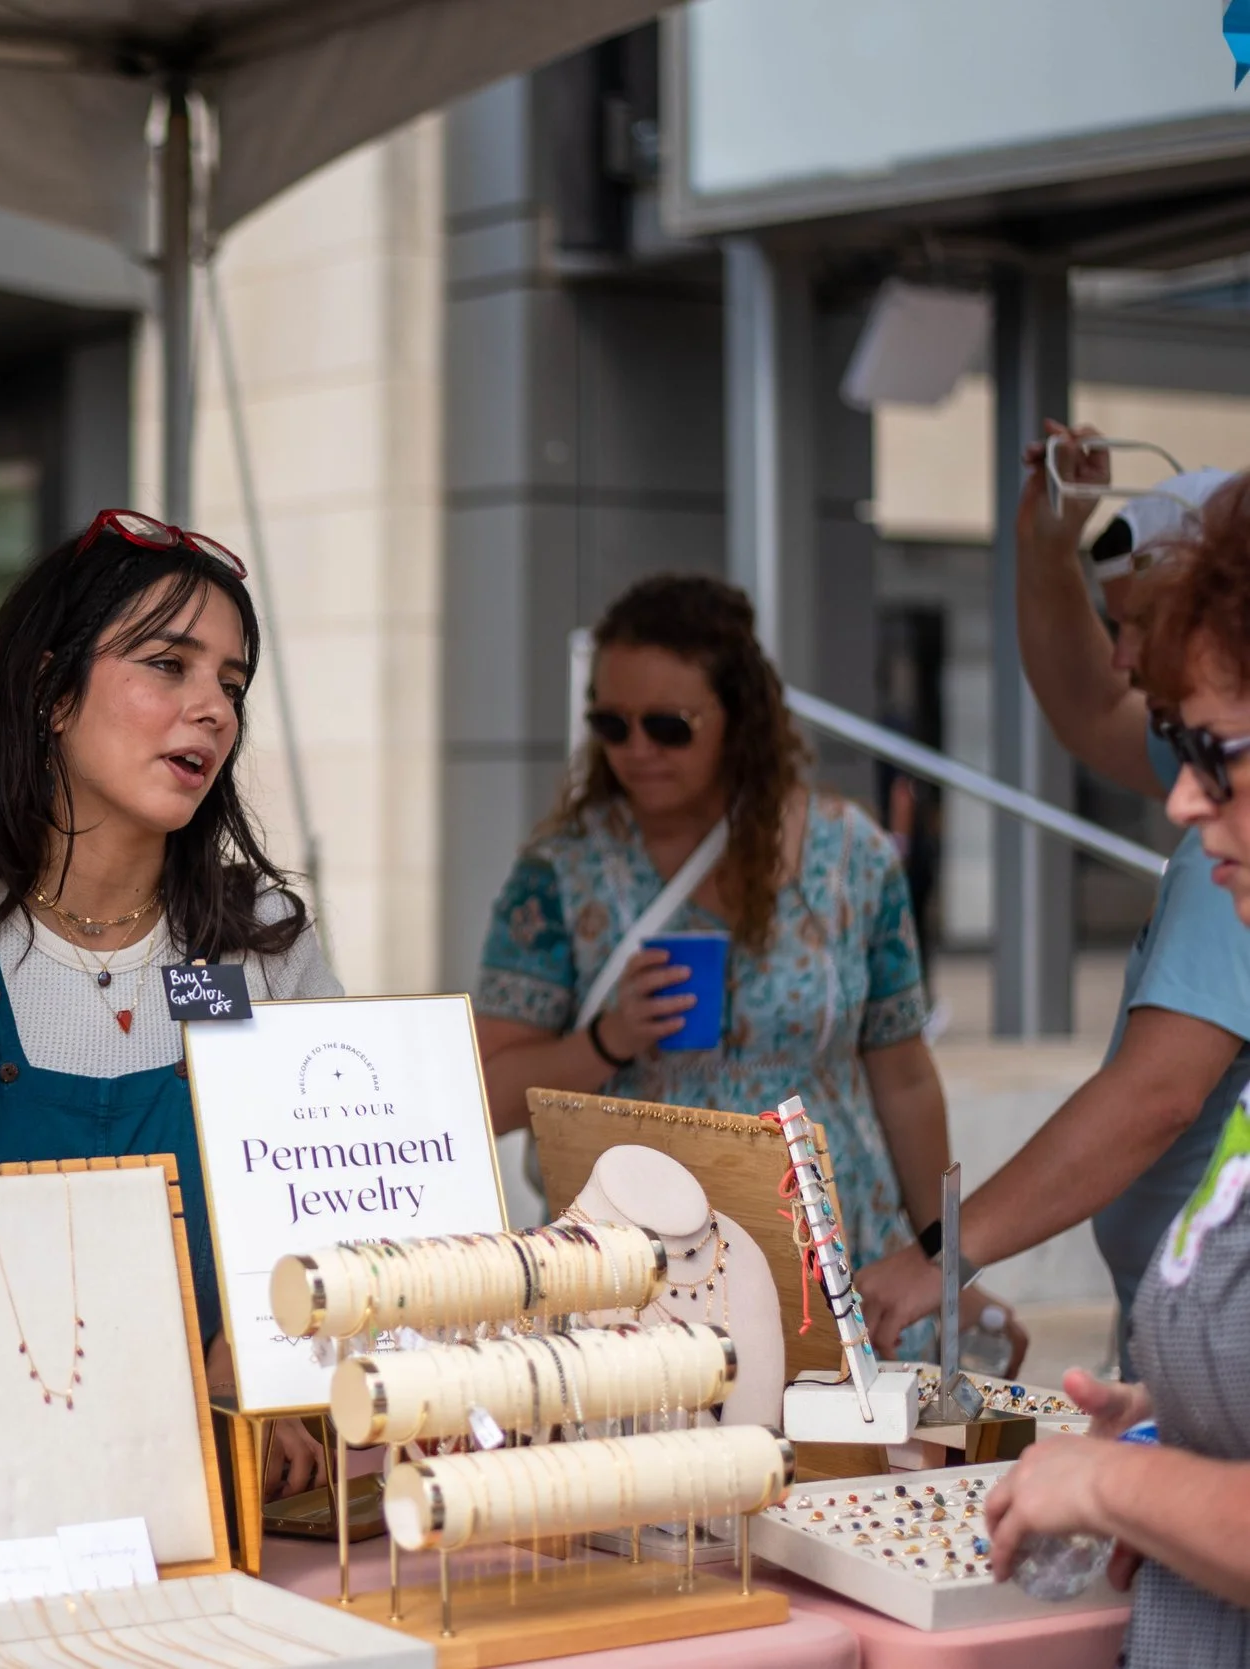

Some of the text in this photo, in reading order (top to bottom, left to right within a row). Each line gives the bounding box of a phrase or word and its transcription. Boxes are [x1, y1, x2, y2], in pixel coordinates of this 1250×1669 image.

[170, 969, 212, 1000] Buy 2
[170, 988, 193, 1005] Get
[299, 1042, 380, 1095] WELCOME TO THE BRACELET BAR
[293, 1103, 395, 1120] GET YOUR
[241, 1131, 456, 1172] Permanent
[287, 1175, 424, 1224] Jewelry
